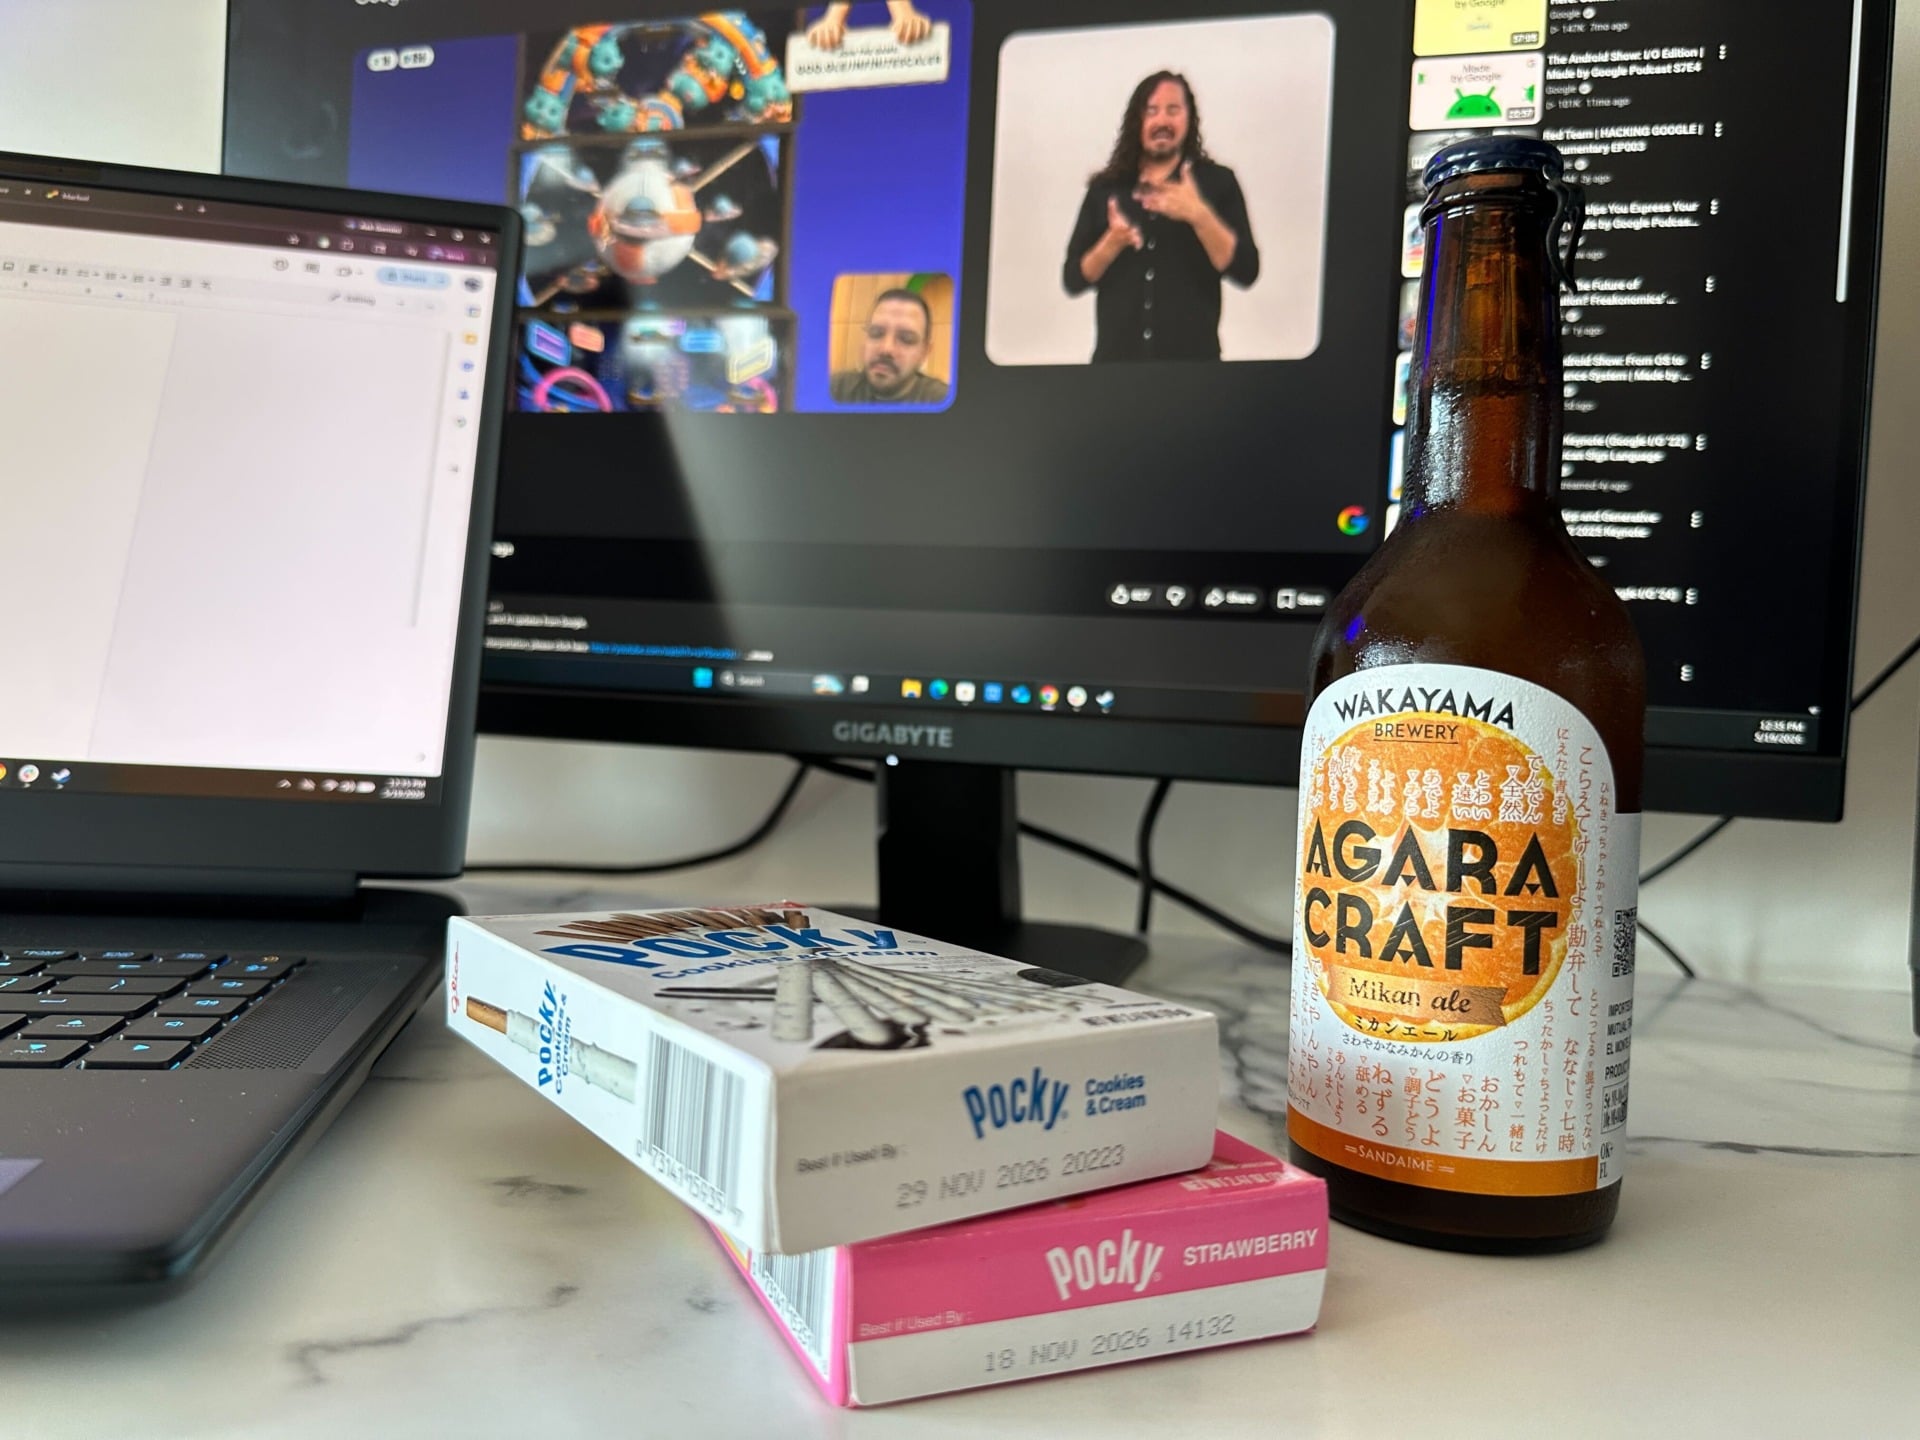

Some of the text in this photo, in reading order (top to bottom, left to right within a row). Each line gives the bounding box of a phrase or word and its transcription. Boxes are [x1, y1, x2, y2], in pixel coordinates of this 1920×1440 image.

[1546, 69, 1576, 81] Made
[1591, 65, 1628, 79] Google
[1629, 62, 1673, 76] Podcast
[1547, 54, 1567, 66] The
[1568, 52, 1609, 65] Android
[1610, 50, 1642, 63] Show:
[1661, 47, 1698, 59] Edition
[1558, 143, 1610, 155] umentary
[1565, 126, 1593, 140] Team
[1600, 125, 1651, 138] HACKING
[1651, 123, 1698, 136] GOOGLE
[1629, 201, 1672, 215] Express
[1333, 686, 1515, 730] WAKAYAMA
[832, 720, 954, 749] GIGABYTE
[1374, 722, 1459, 740] BREWERY
[1454, 784, 1472, 819] 遠い
[1473, 770, 1492, 819] とわい
[1500, 777, 1523, 820] 全然
[1524, 755, 1544, 823] でんでん
[1305, 815, 1560, 899] AGARA
[1304, 886, 1559, 976] CRAFT
[650, 953, 793, 979] Cookies
[814, 948, 939, 961] Cream
[1349, 976, 1472, 1014] Mikan ale
[561, 1016, 573, 1078] Cream
[1354, 1014, 1458, 1042] ミカンエール
[555, 1007, 567, 1095] Cookies
[1341, 1032, 1474, 1066] さわやかなみかんの香り
[962, 1066, 1070, 1139] Pocky
[1085, 1073, 1146, 1096] Cookies
[1371, 1061, 1394, 1137] ねずる
[1085, 1092, 1147, 1117] & Cream
[1420, 1068, 1447, 1147] どうよ
[1453, 1086, 1477, 1150] お菓子
[1477, 1075, 1501, 1153] おかしん
[897, 1142, 1127, 1208] 29 NOV 2026 20223
[1357, 1144, 1435, 1173] SANDAIME
[1045, 1228, 1165, 1301] Pocky
[1183, 1228, 1320, 1267] STRAWBERRY
[859, 1322, 893, 1337] Best
[907, 1313, 943, 1330] Used
[984, 1313, 1236, 1372] 18 NOV 2026 14132
